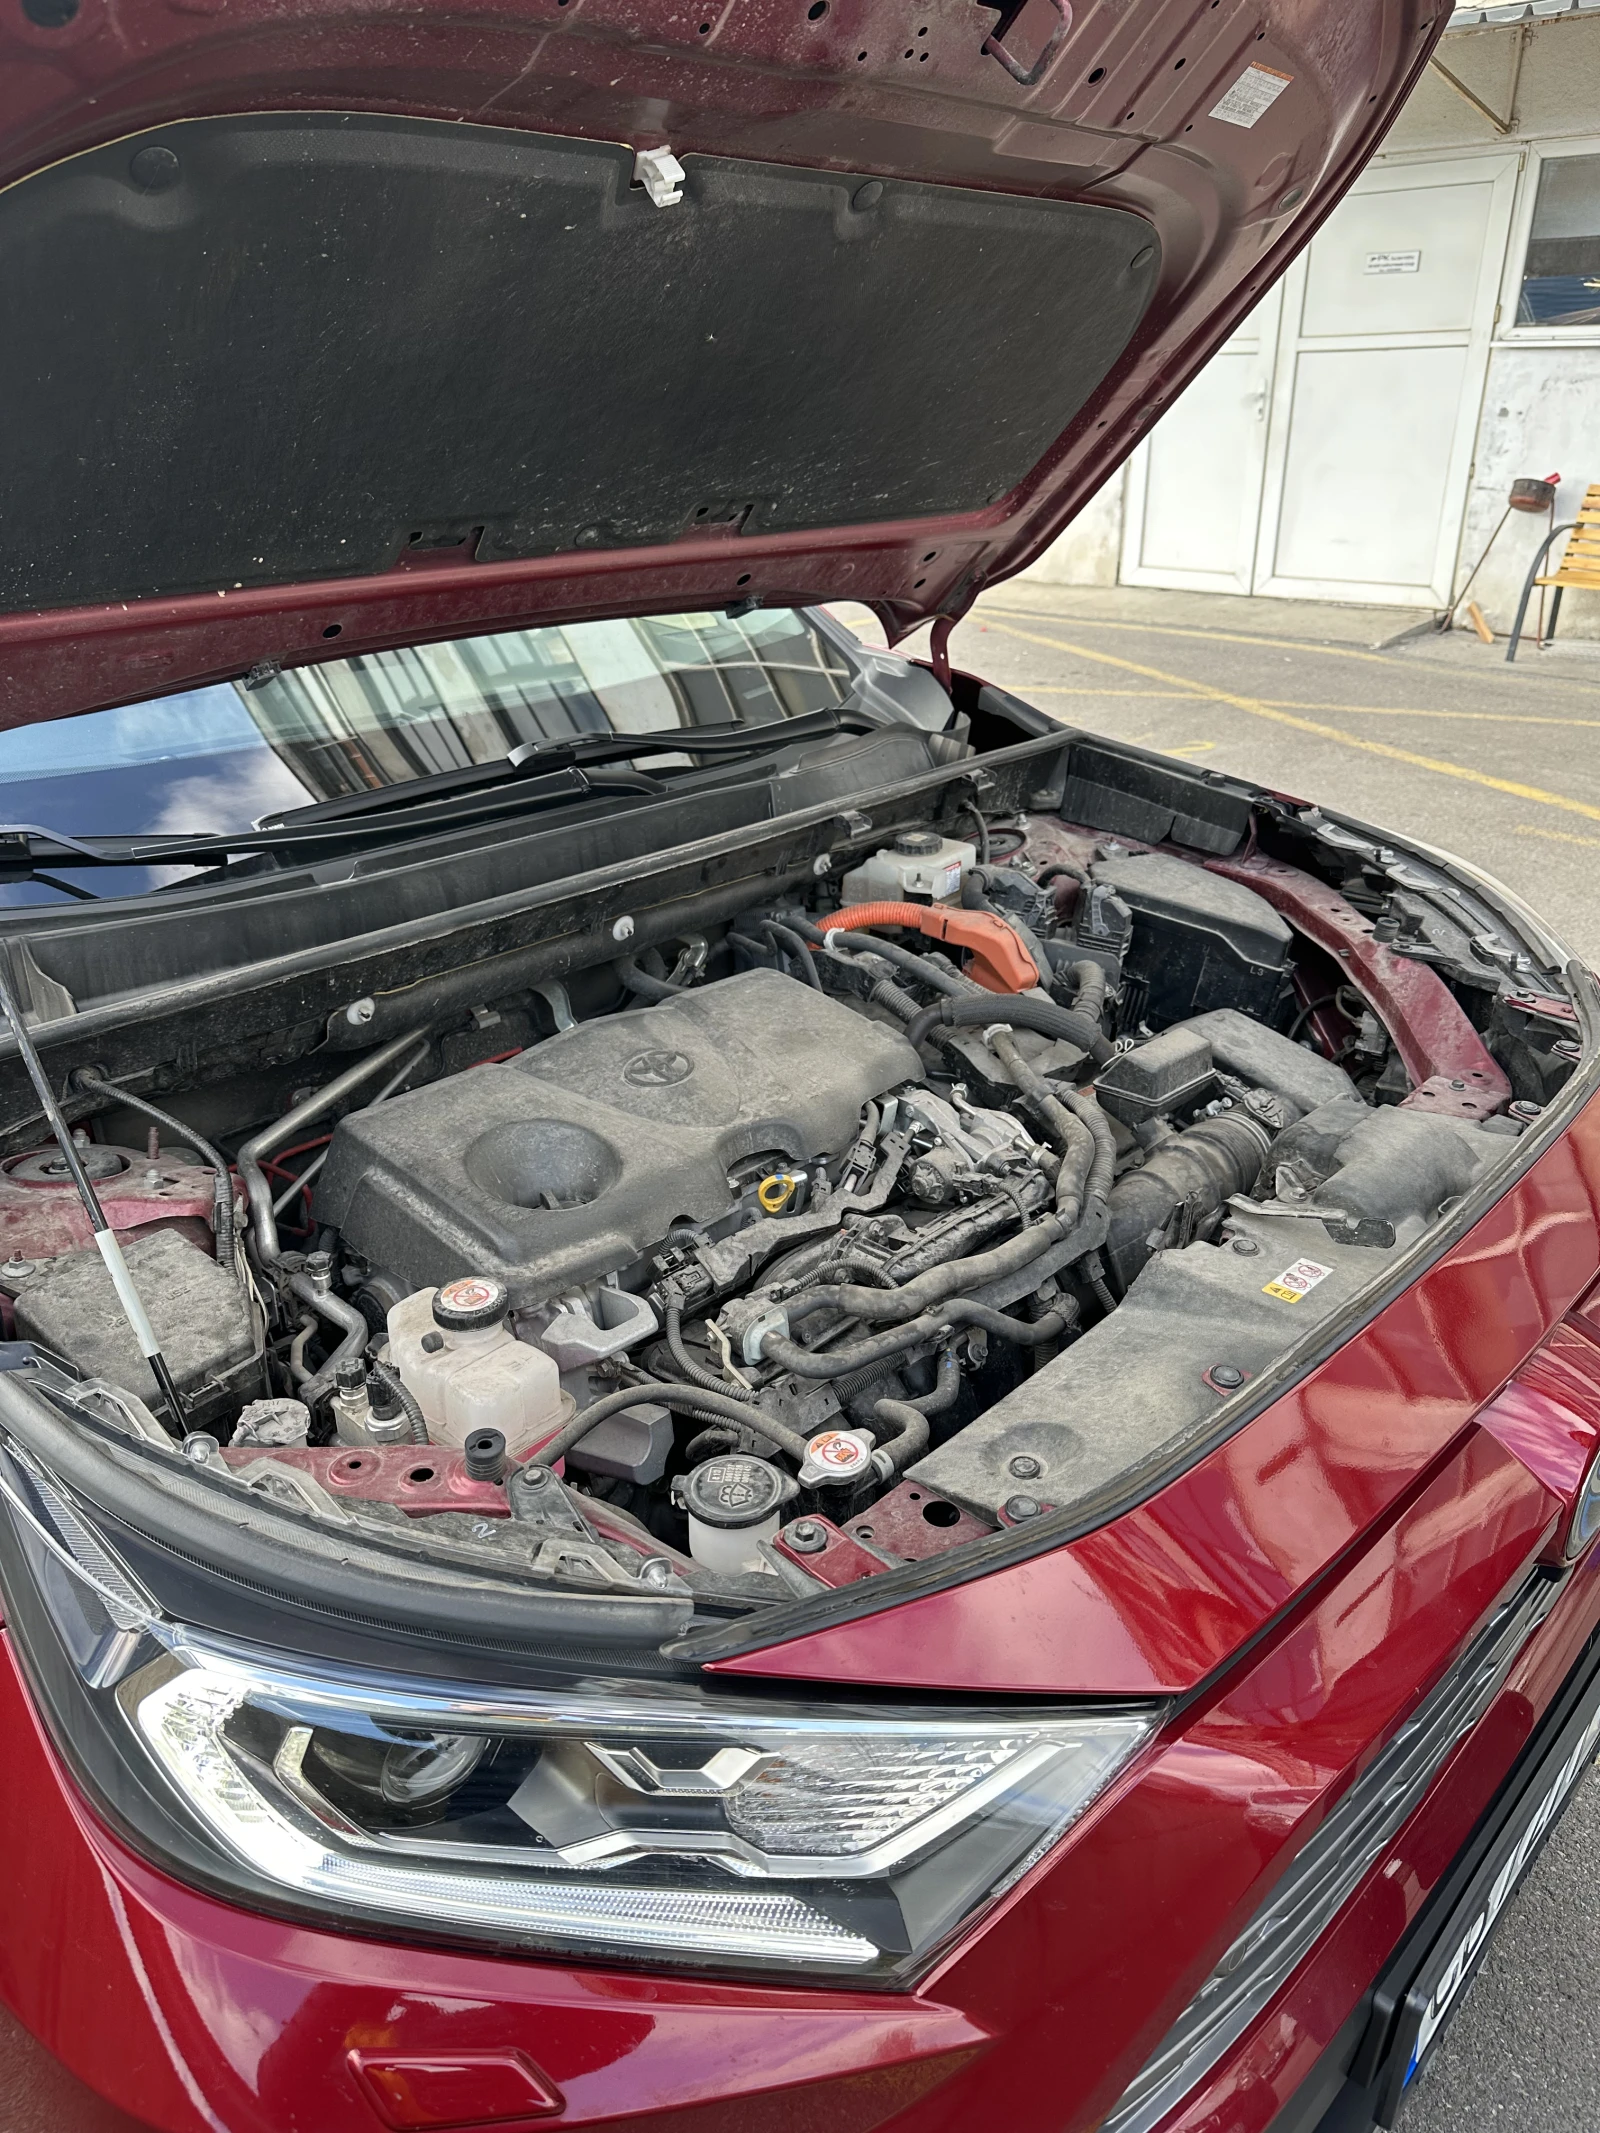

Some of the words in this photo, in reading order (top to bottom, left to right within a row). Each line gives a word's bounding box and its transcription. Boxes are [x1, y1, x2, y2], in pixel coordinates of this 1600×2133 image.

[1249, 966, 1264, 976] L3
[472, 1522, 497, 1539] 2
[619, 1951, 670, 1965] STANLEY
